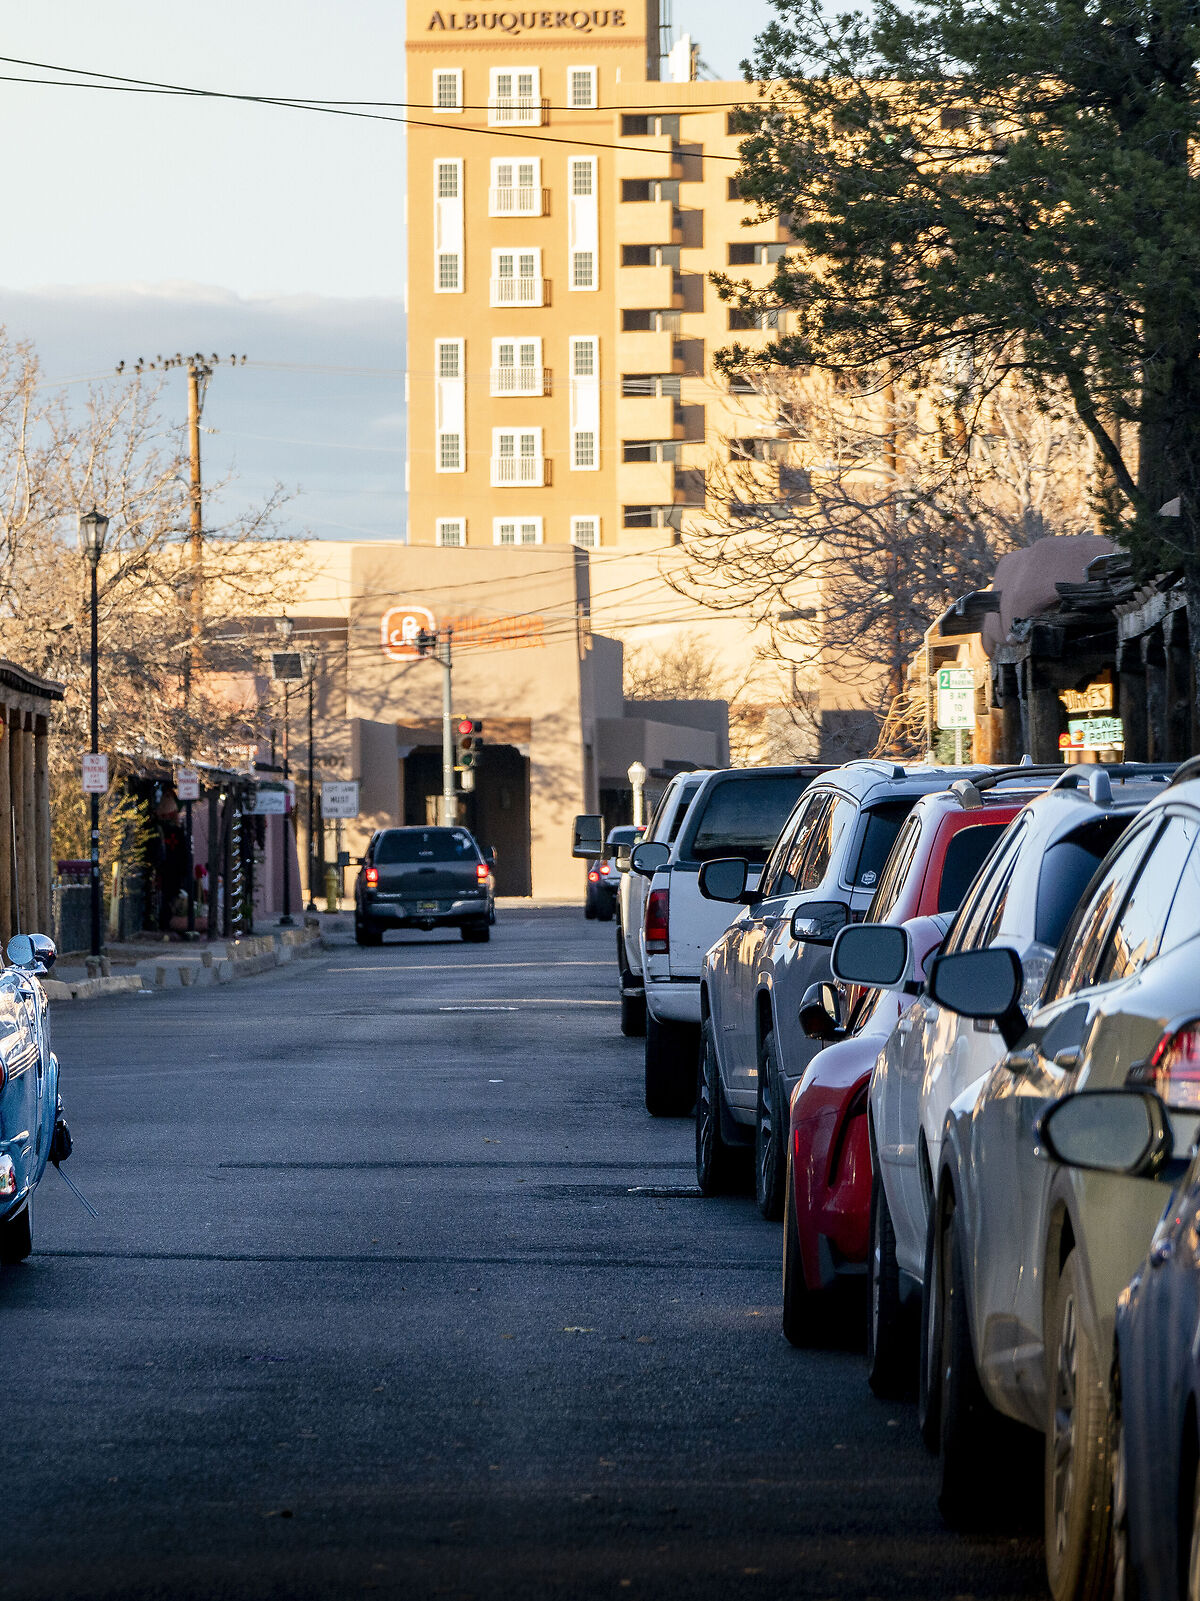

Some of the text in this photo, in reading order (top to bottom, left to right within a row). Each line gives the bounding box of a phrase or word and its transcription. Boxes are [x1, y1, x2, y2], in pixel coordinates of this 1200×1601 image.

[427, 9, 626, 35] ALBUQUERQUE
[941, 672, 949, 687] 2
[1083, 719, 1122, 731] TALAVE
[330, 795, 349, 803] MUST
